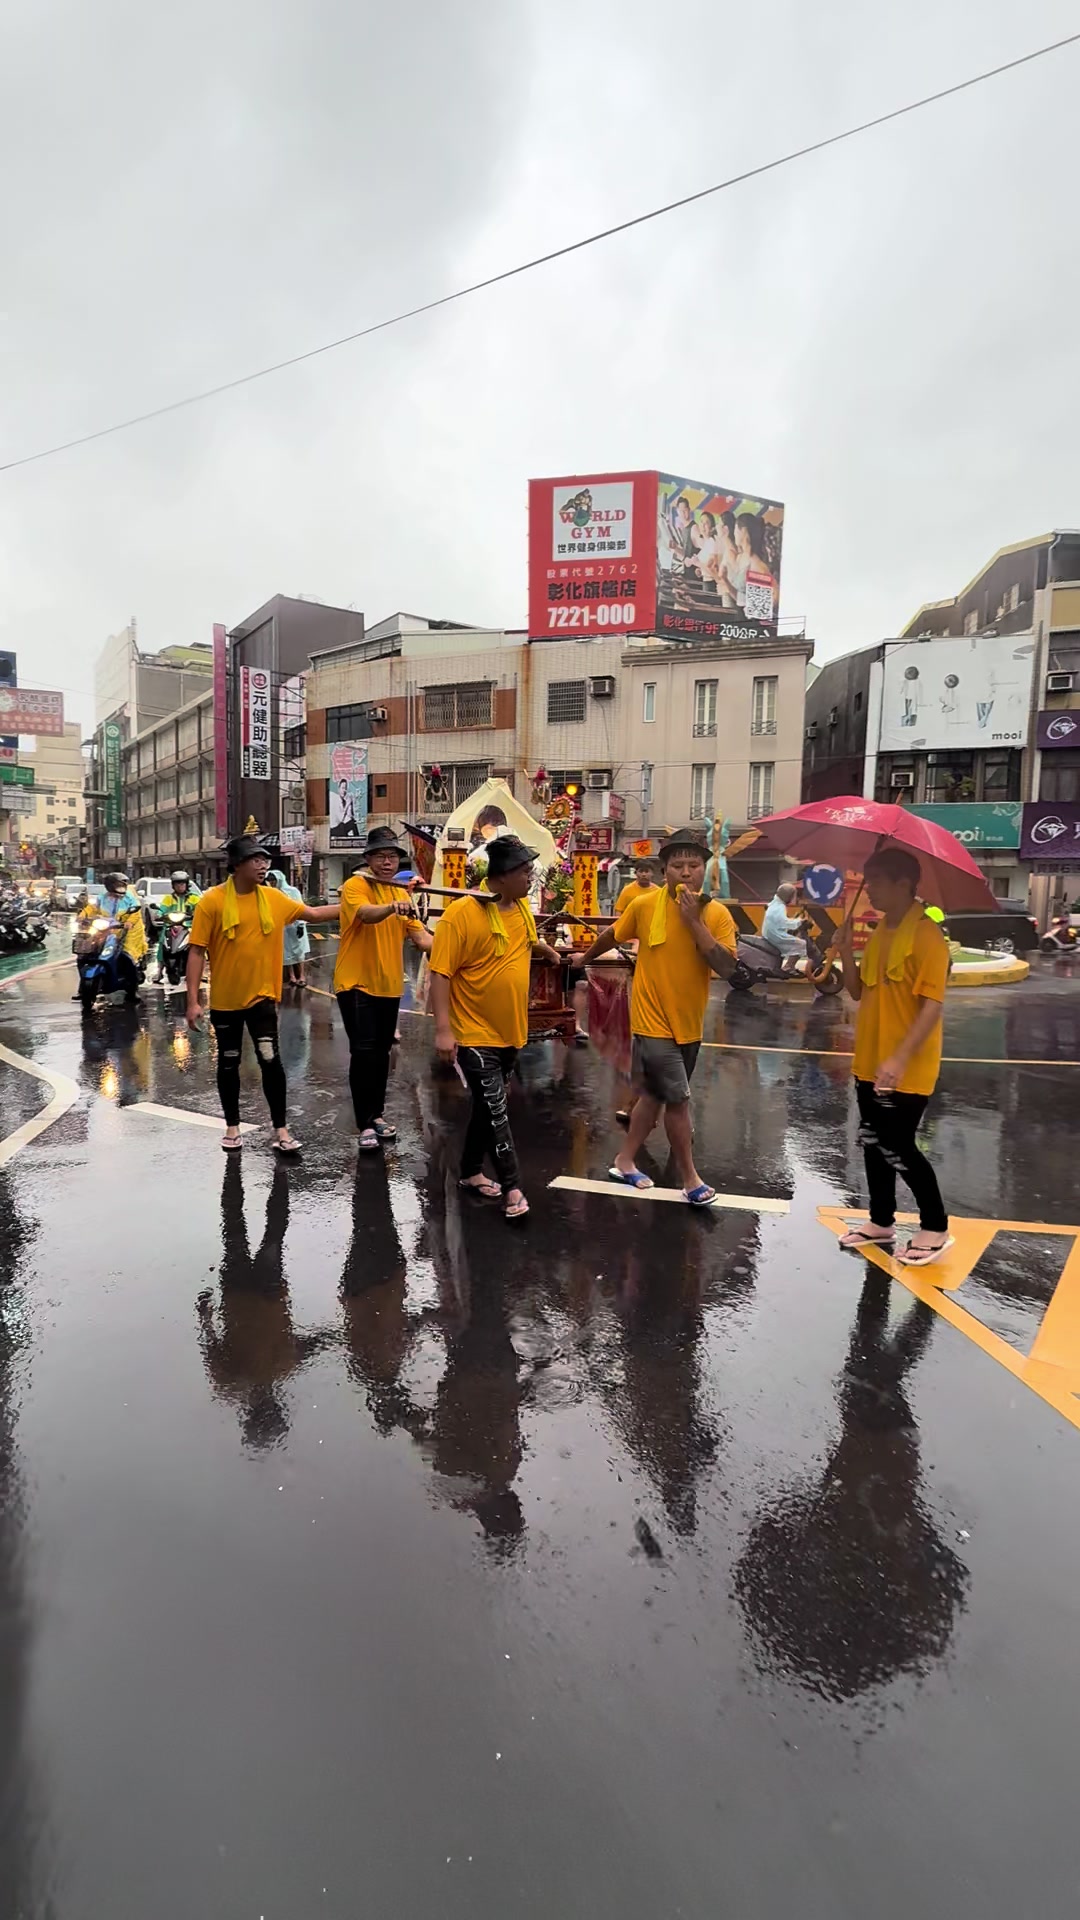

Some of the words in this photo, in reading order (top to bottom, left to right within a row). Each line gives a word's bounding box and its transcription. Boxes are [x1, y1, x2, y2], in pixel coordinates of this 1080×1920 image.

[571, 526, 612, 539] GYM
[557, 540, 627, 554] 世界健身俱樂部
[547, 579, 637, 601] 彰化旗艦店
[547, 602, 636, 628] 7221-000
[991, 730, 1022, 740] mooi
